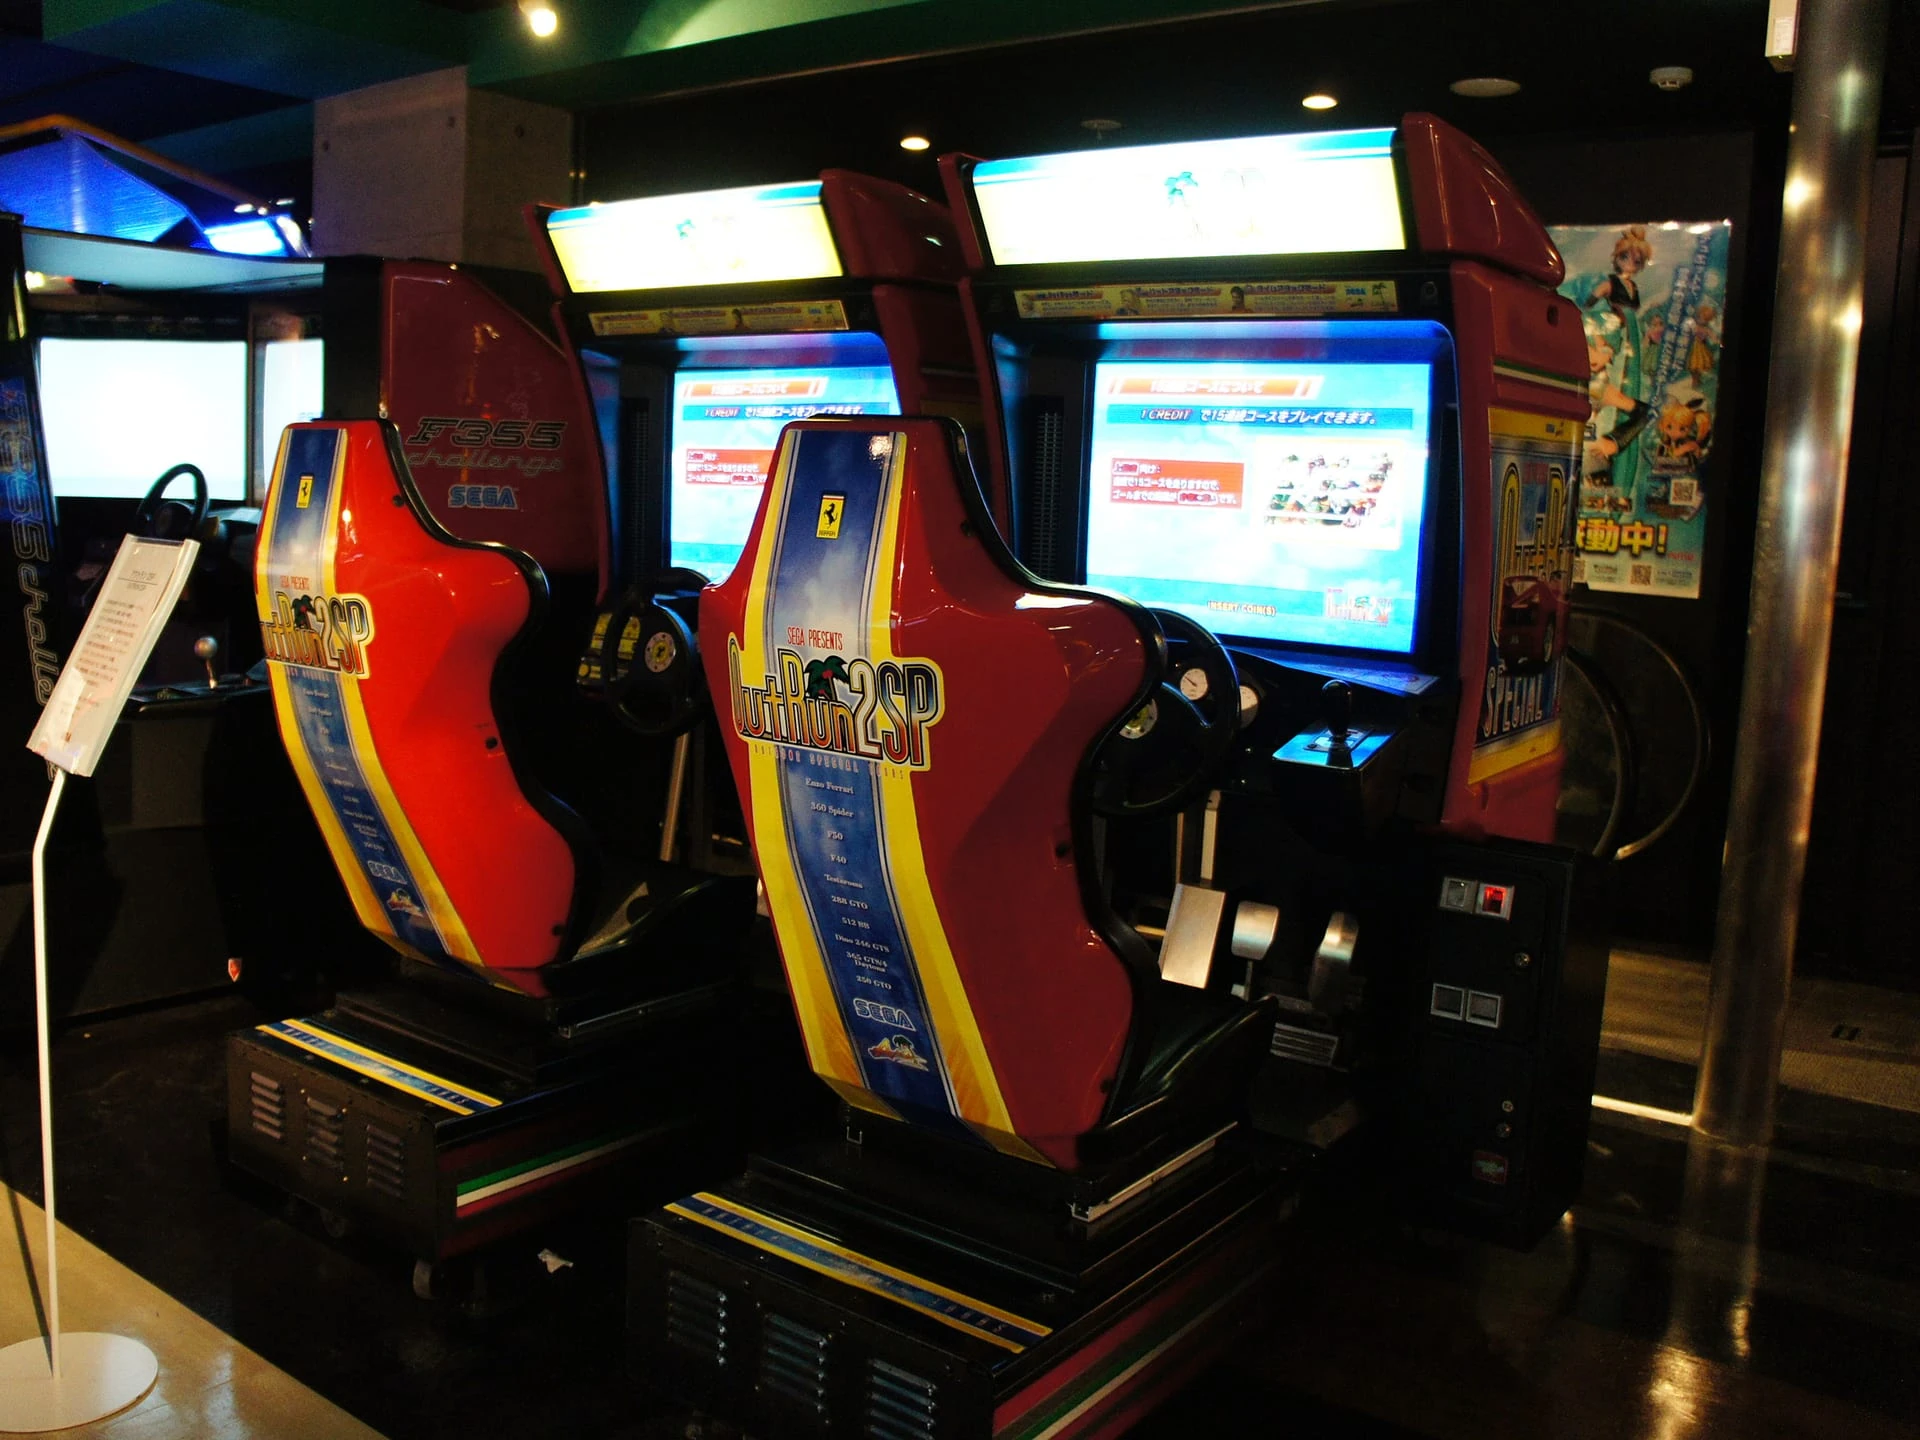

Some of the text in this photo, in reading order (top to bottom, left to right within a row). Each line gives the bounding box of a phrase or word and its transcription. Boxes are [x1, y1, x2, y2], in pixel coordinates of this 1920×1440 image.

[1149, 409, 1193, 421] CREDIT
[406, 416, 568, 451] F355
[448, 484, 518, 510] SEGA
[787, 627, 843, 651] SEGA PRESENTS
[805, 778, 855, 796] Enzo Ferrari
[810, 801, 855, 819] 360 Spider
[849, 899, 869, 911] GTO
[841, 917, 857, 927] 512
[873, 979, 893, 992] GTO
[853, 998, 916, 1032] SEGA
